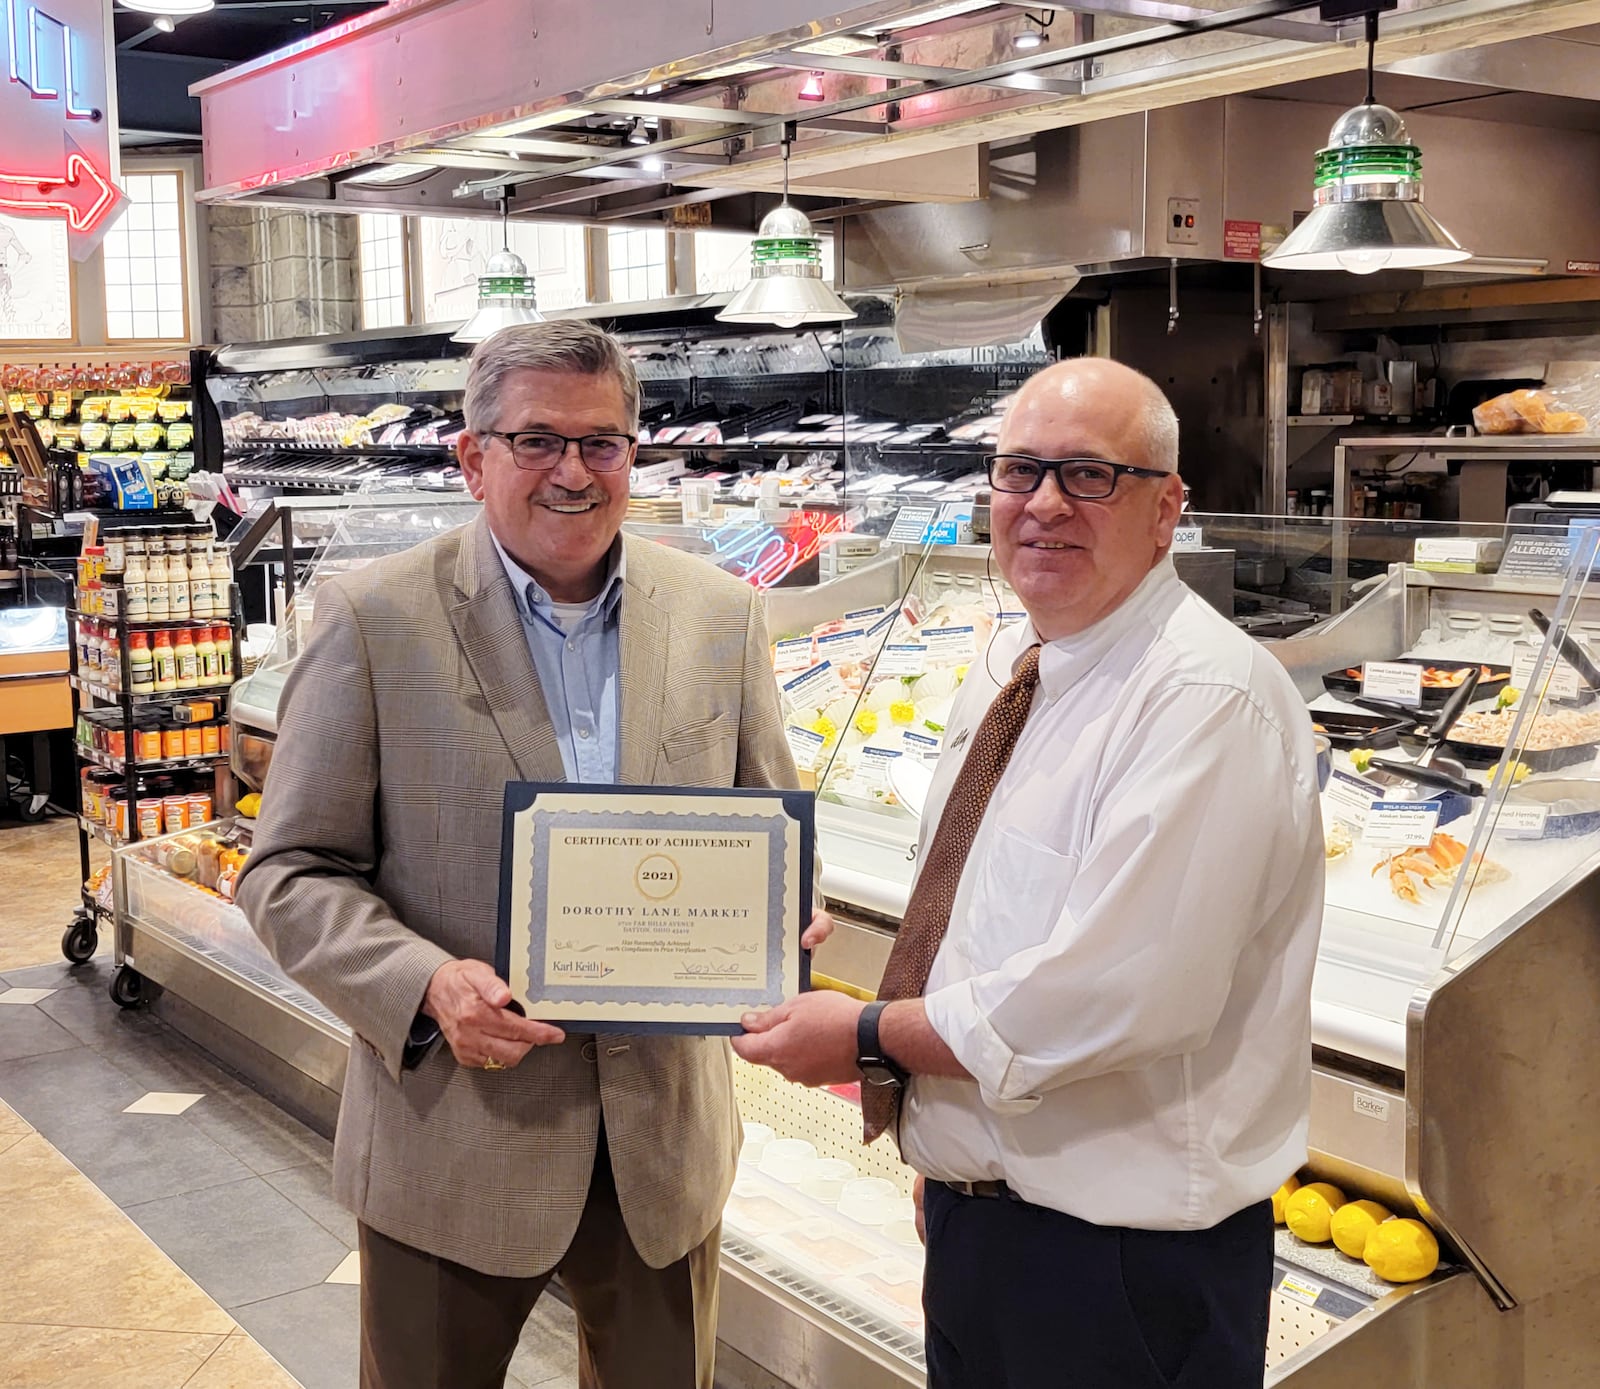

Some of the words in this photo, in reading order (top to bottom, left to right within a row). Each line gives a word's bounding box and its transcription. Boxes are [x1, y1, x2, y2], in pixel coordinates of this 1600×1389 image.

[1510, 546, 1571, 556] ALLERGENS
[1515, 812, 1540, 820] Herring
[564, 836, 642, 846] CERTIFICATE
[645, 837, 661, 847] OF
[664, 838, 752, 848] ACHIEVEMENT
[642, 872, 673, 880] 2021
[562, 905, 634, 916] DOROTHY
[642, 907, 681, 917] LANE
[687, 907, 750, 918] MARKET
[634, 940, 666, 948] Successfully
[553, 961, 573, 972] Karl
[575, 961, 600, 973] Keith
[1356, 1097, 1384, 1115] Barker
